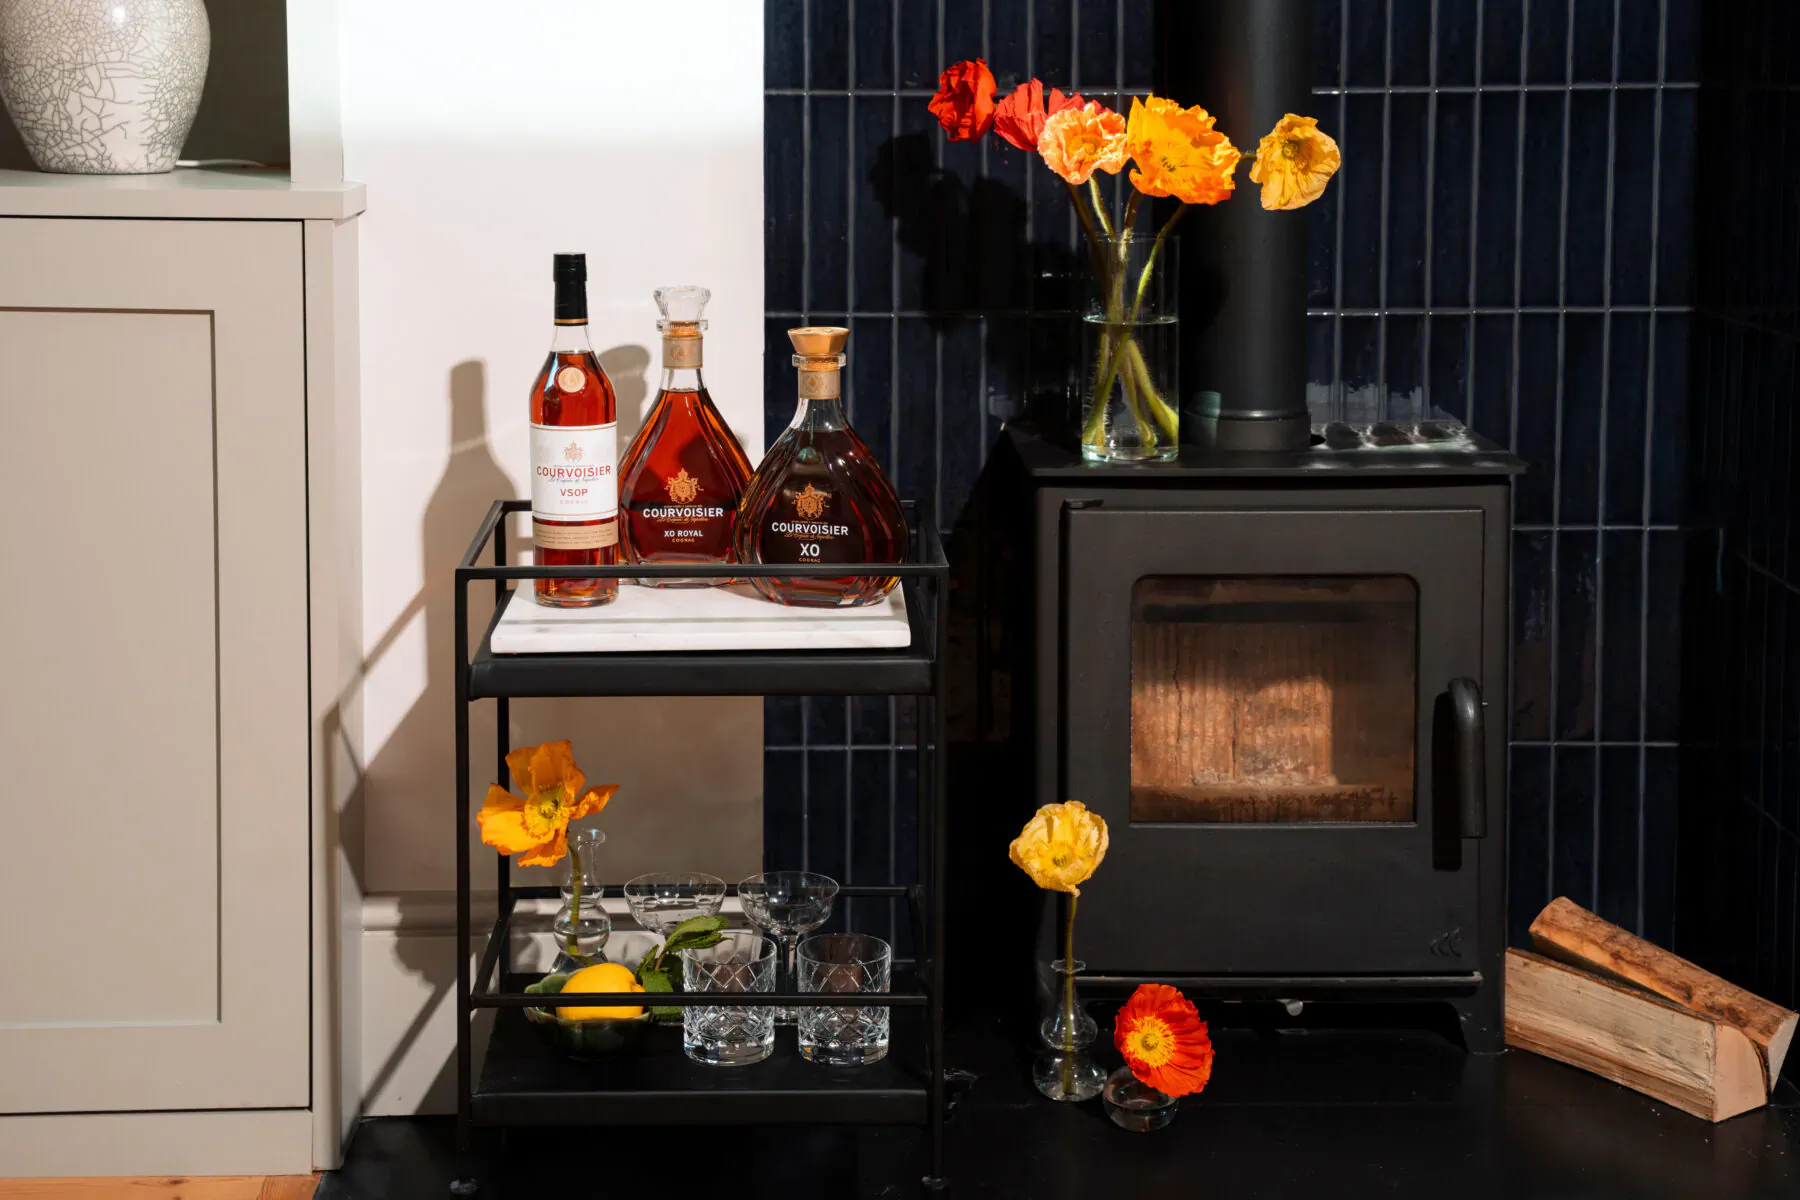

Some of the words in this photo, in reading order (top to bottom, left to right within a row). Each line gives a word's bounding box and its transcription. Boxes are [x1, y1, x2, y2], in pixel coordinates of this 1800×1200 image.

[536, 465, 611, 478] COURVOISIER
[559, 488, 588, 497] VSOP
[642, 507, 724, 518] COURVOISIER
[771, 521, 849, 536] COURVOISIER
[800, 543, 820, 557] XO
